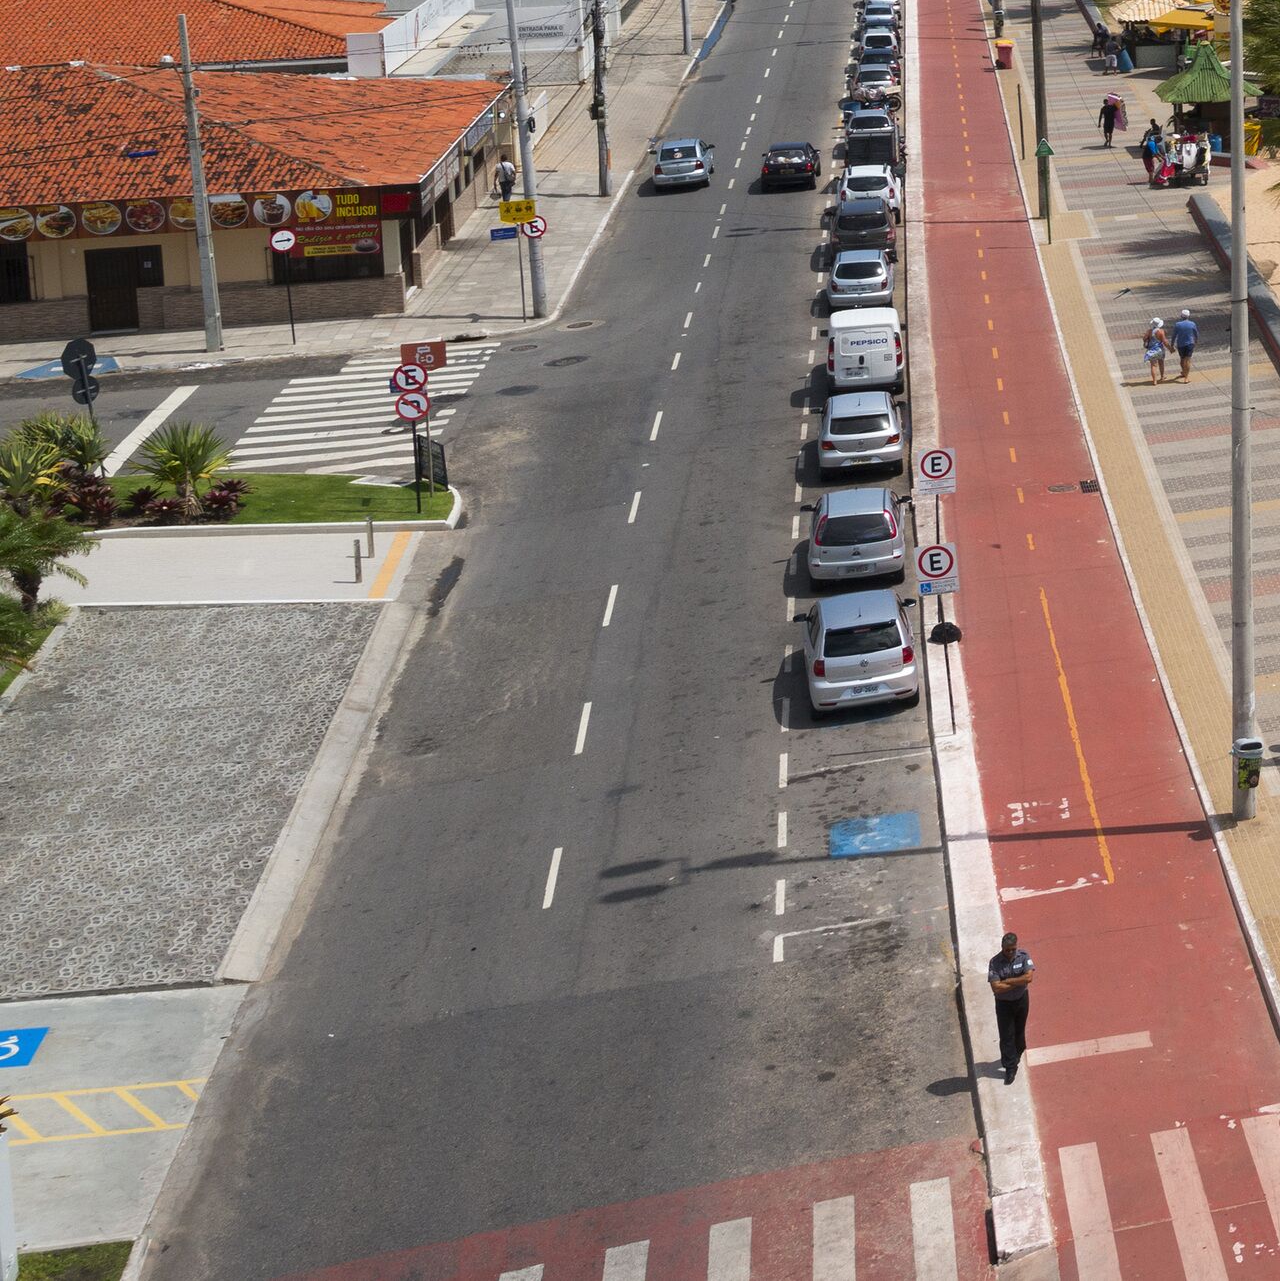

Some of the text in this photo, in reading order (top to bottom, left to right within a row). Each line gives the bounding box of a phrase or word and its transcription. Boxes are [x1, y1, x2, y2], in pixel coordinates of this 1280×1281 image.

[336, 194, 359, 205] TUDO
[336, 206, 377, 217] INCLUSO!
[850, 338, 888, 346] PEPSICO
[931, 456, 942, 473] E
[929, 553, 943, 572] E
